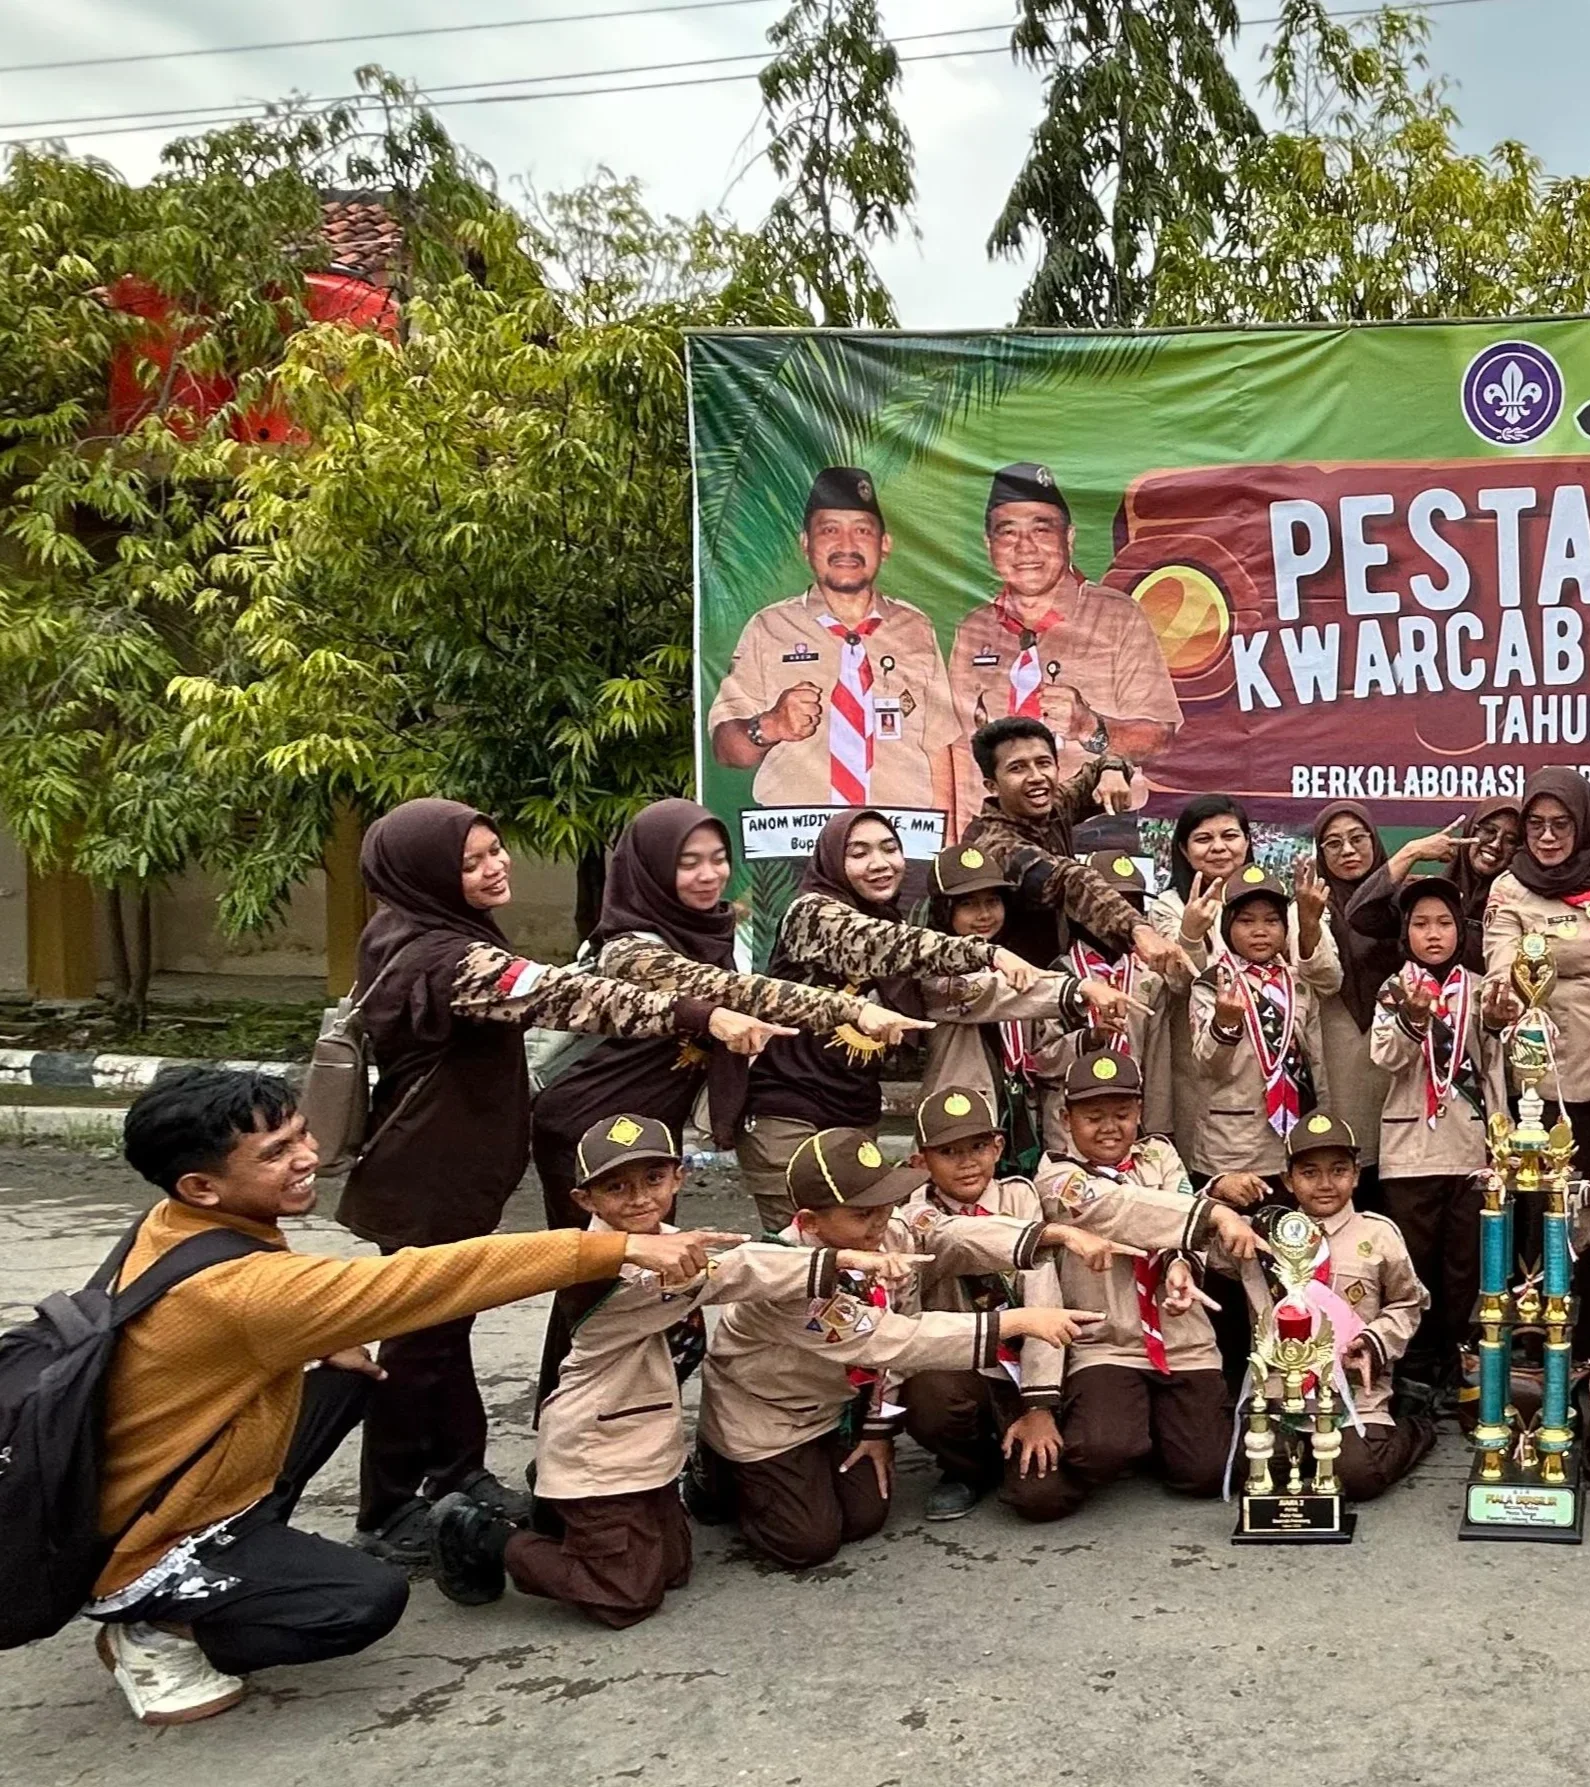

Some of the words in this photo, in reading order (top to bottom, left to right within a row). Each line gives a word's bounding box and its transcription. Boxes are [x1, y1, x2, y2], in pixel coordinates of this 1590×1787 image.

[1231, 606, 1585, 712] KWARCAB
[749, 816, 788, 832] ANOM
[791, 837, 816, 852] Bup
